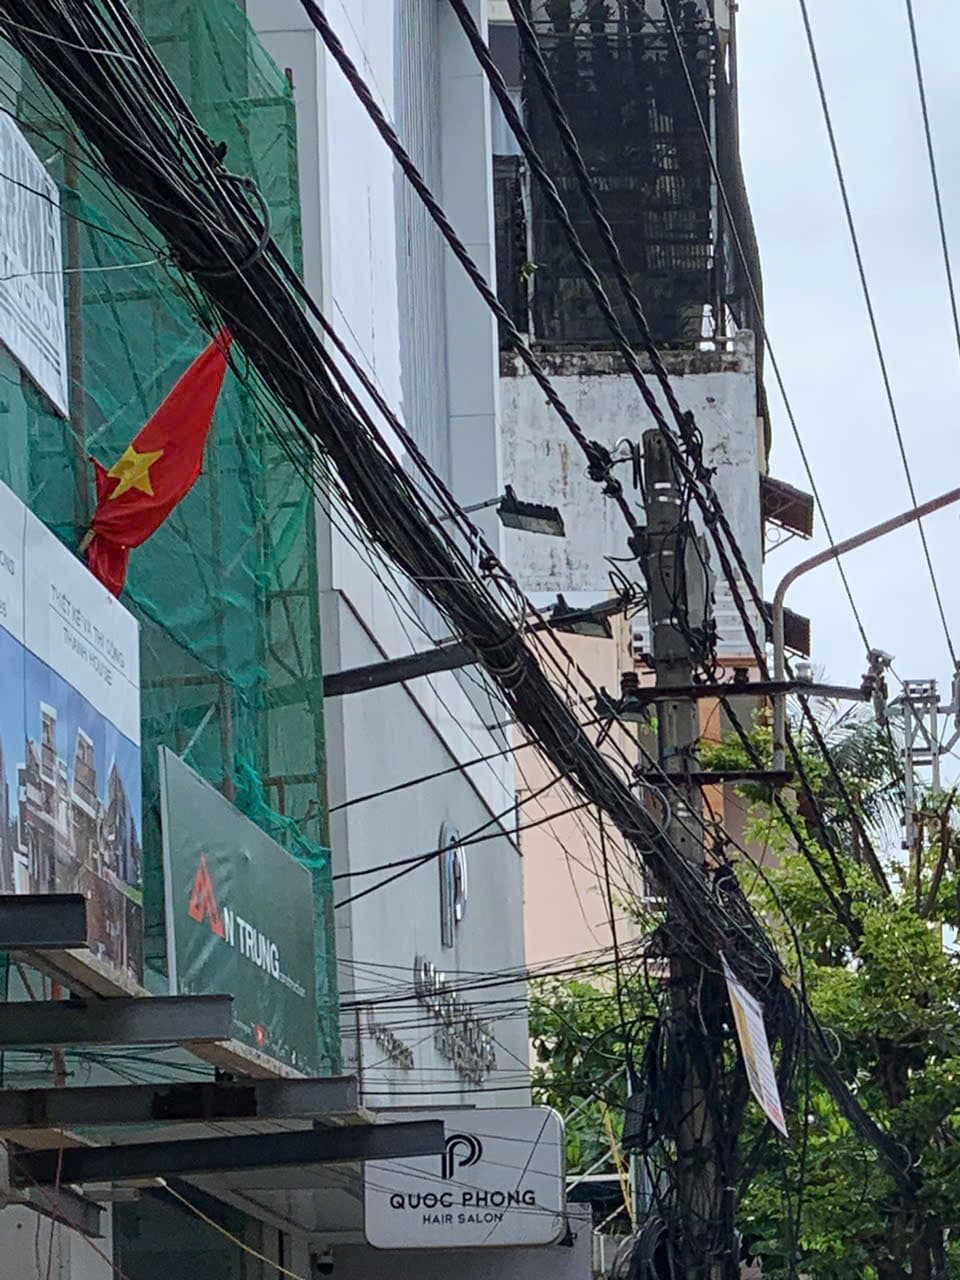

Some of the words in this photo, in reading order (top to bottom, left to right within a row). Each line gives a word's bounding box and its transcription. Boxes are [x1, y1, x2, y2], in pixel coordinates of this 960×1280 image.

[236, 916, 280, 981] TRUNG
[390, 1192, 453, 1209] QUOC
[462, 1190, 536, 1207] PHONG
[423, 1213, 453, 1225] HAIR
[458, 1212, 503, 1224] SALON
